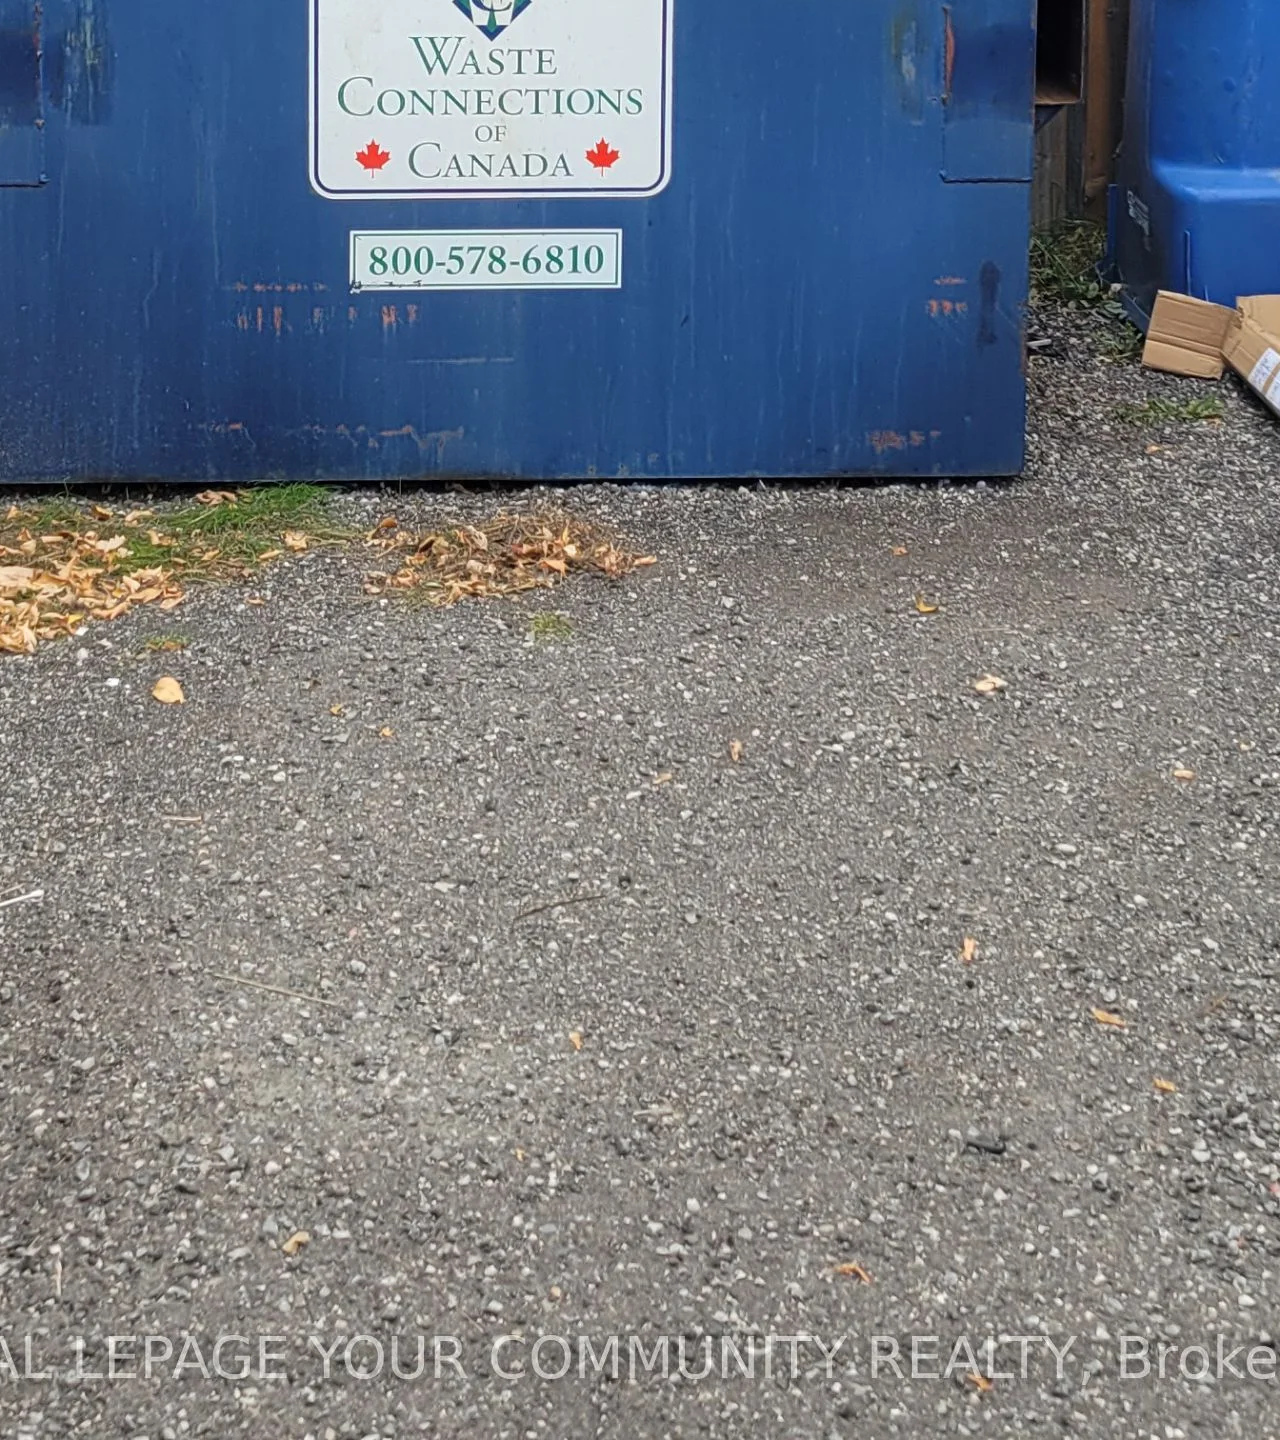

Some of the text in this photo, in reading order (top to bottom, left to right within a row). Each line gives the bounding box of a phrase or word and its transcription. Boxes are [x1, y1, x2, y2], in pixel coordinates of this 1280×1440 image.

[409, 36, 558, 77] WASTE
[337, 76, 643, 116] CONNECTIONS
[474, 125, 507, 143] OF
[408, 142, 574, 179] CANADA
[368, 244, 604, 276] 800-578-6810
